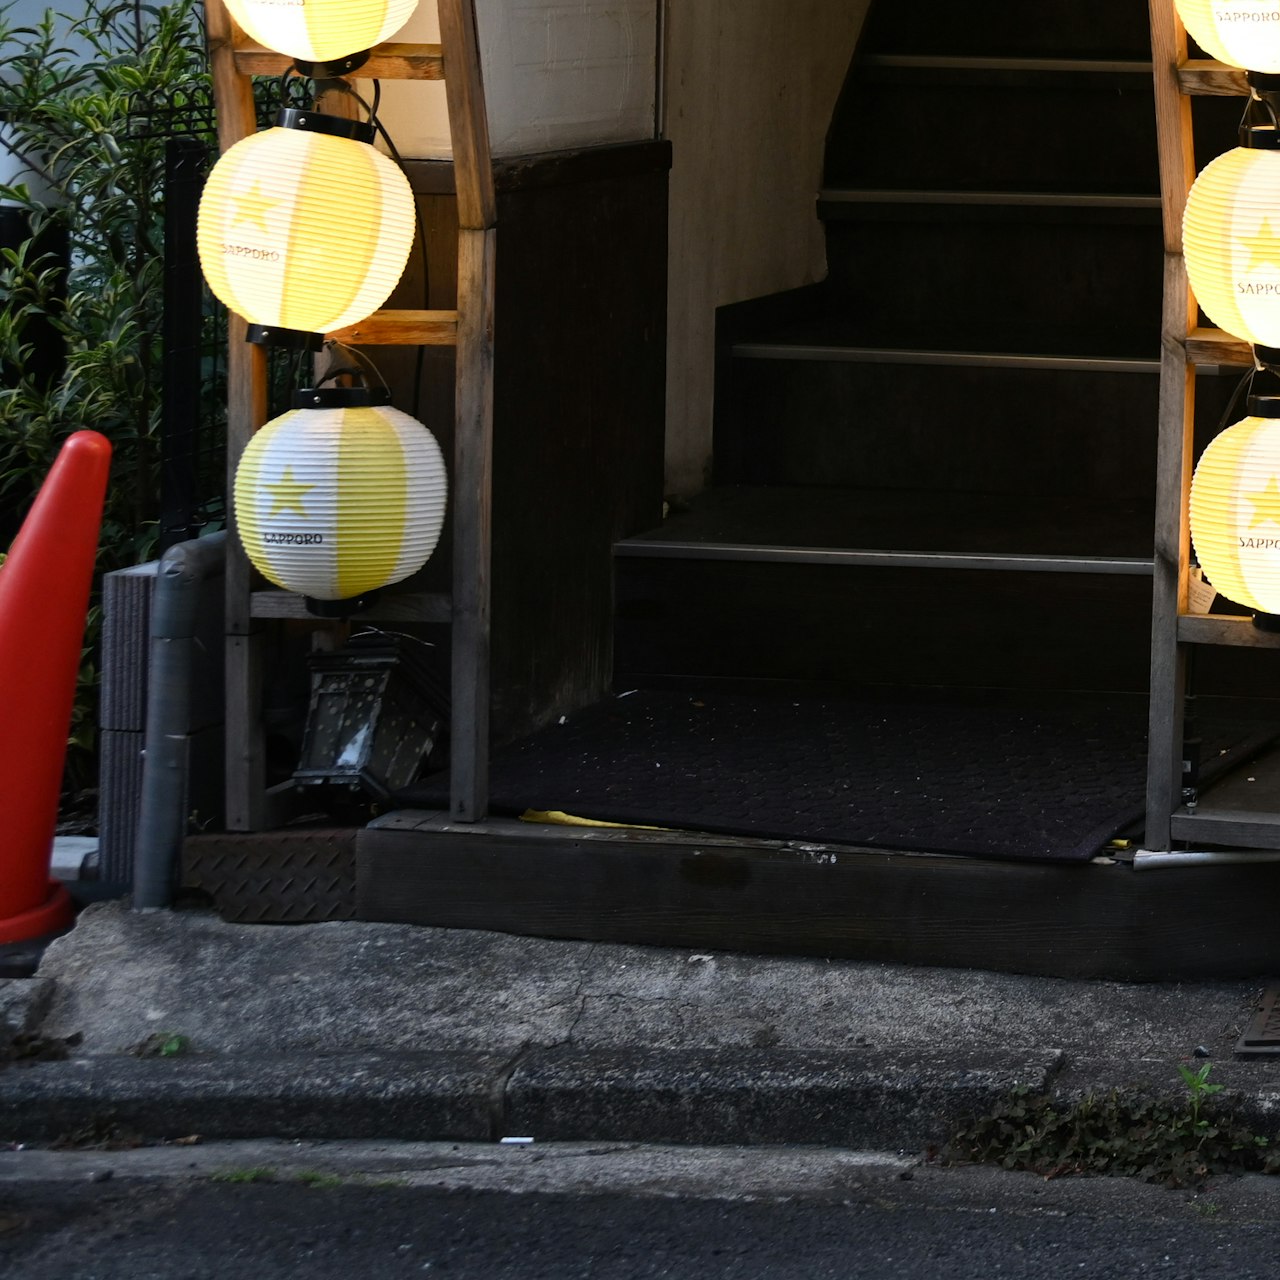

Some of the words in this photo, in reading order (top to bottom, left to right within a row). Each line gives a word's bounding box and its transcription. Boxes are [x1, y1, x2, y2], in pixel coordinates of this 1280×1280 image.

[1215, 11, 1280, 22] SAPPORO
[220, 243, 280, 262] SAPPORO
[263, 533, 324, 545] SAPPORO
